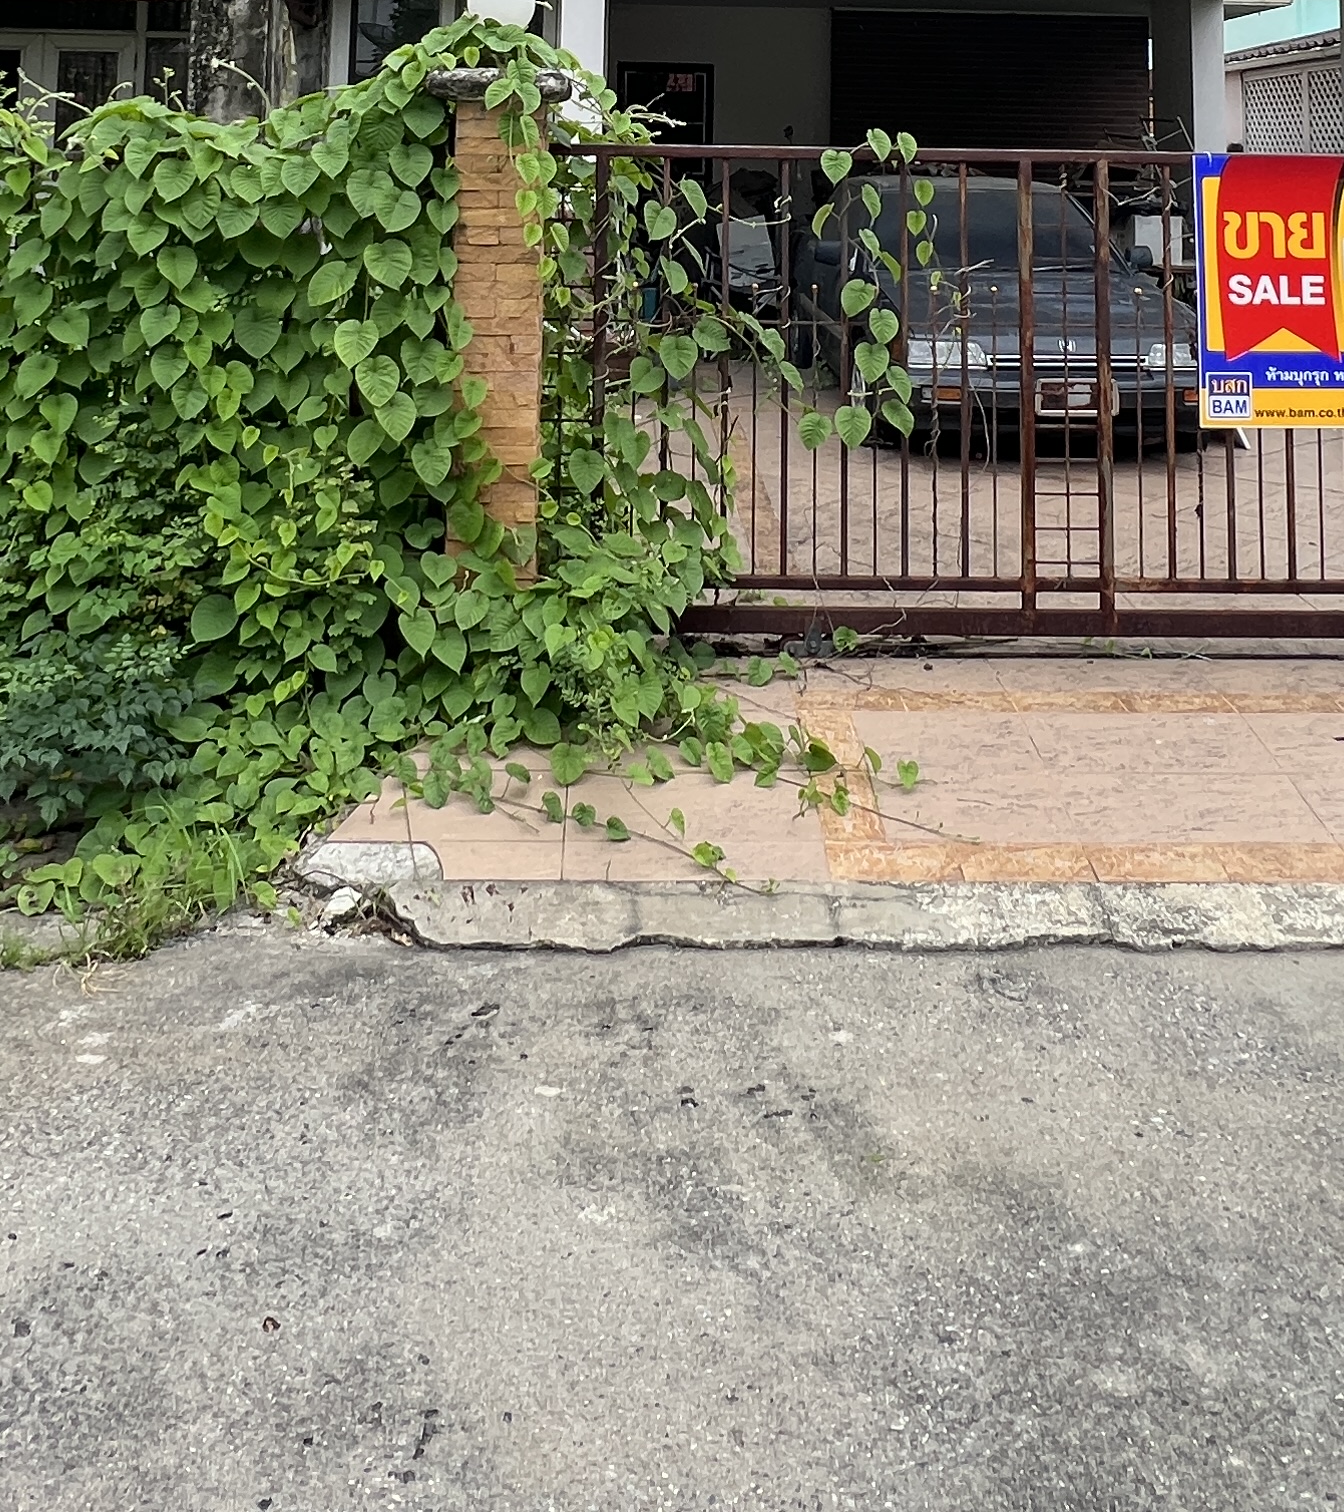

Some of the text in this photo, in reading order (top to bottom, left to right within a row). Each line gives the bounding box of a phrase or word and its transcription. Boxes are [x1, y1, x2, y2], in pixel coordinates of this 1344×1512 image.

[1223, 211, 1327, 259] ขาย
[1227, 274, 1327, 305] SALE
[1210, 378, 1247, 394] บสก
[1265, 366, 1329, 386] ห้ามบุกรุก
[1212, 399, 1248, 415] BAM
